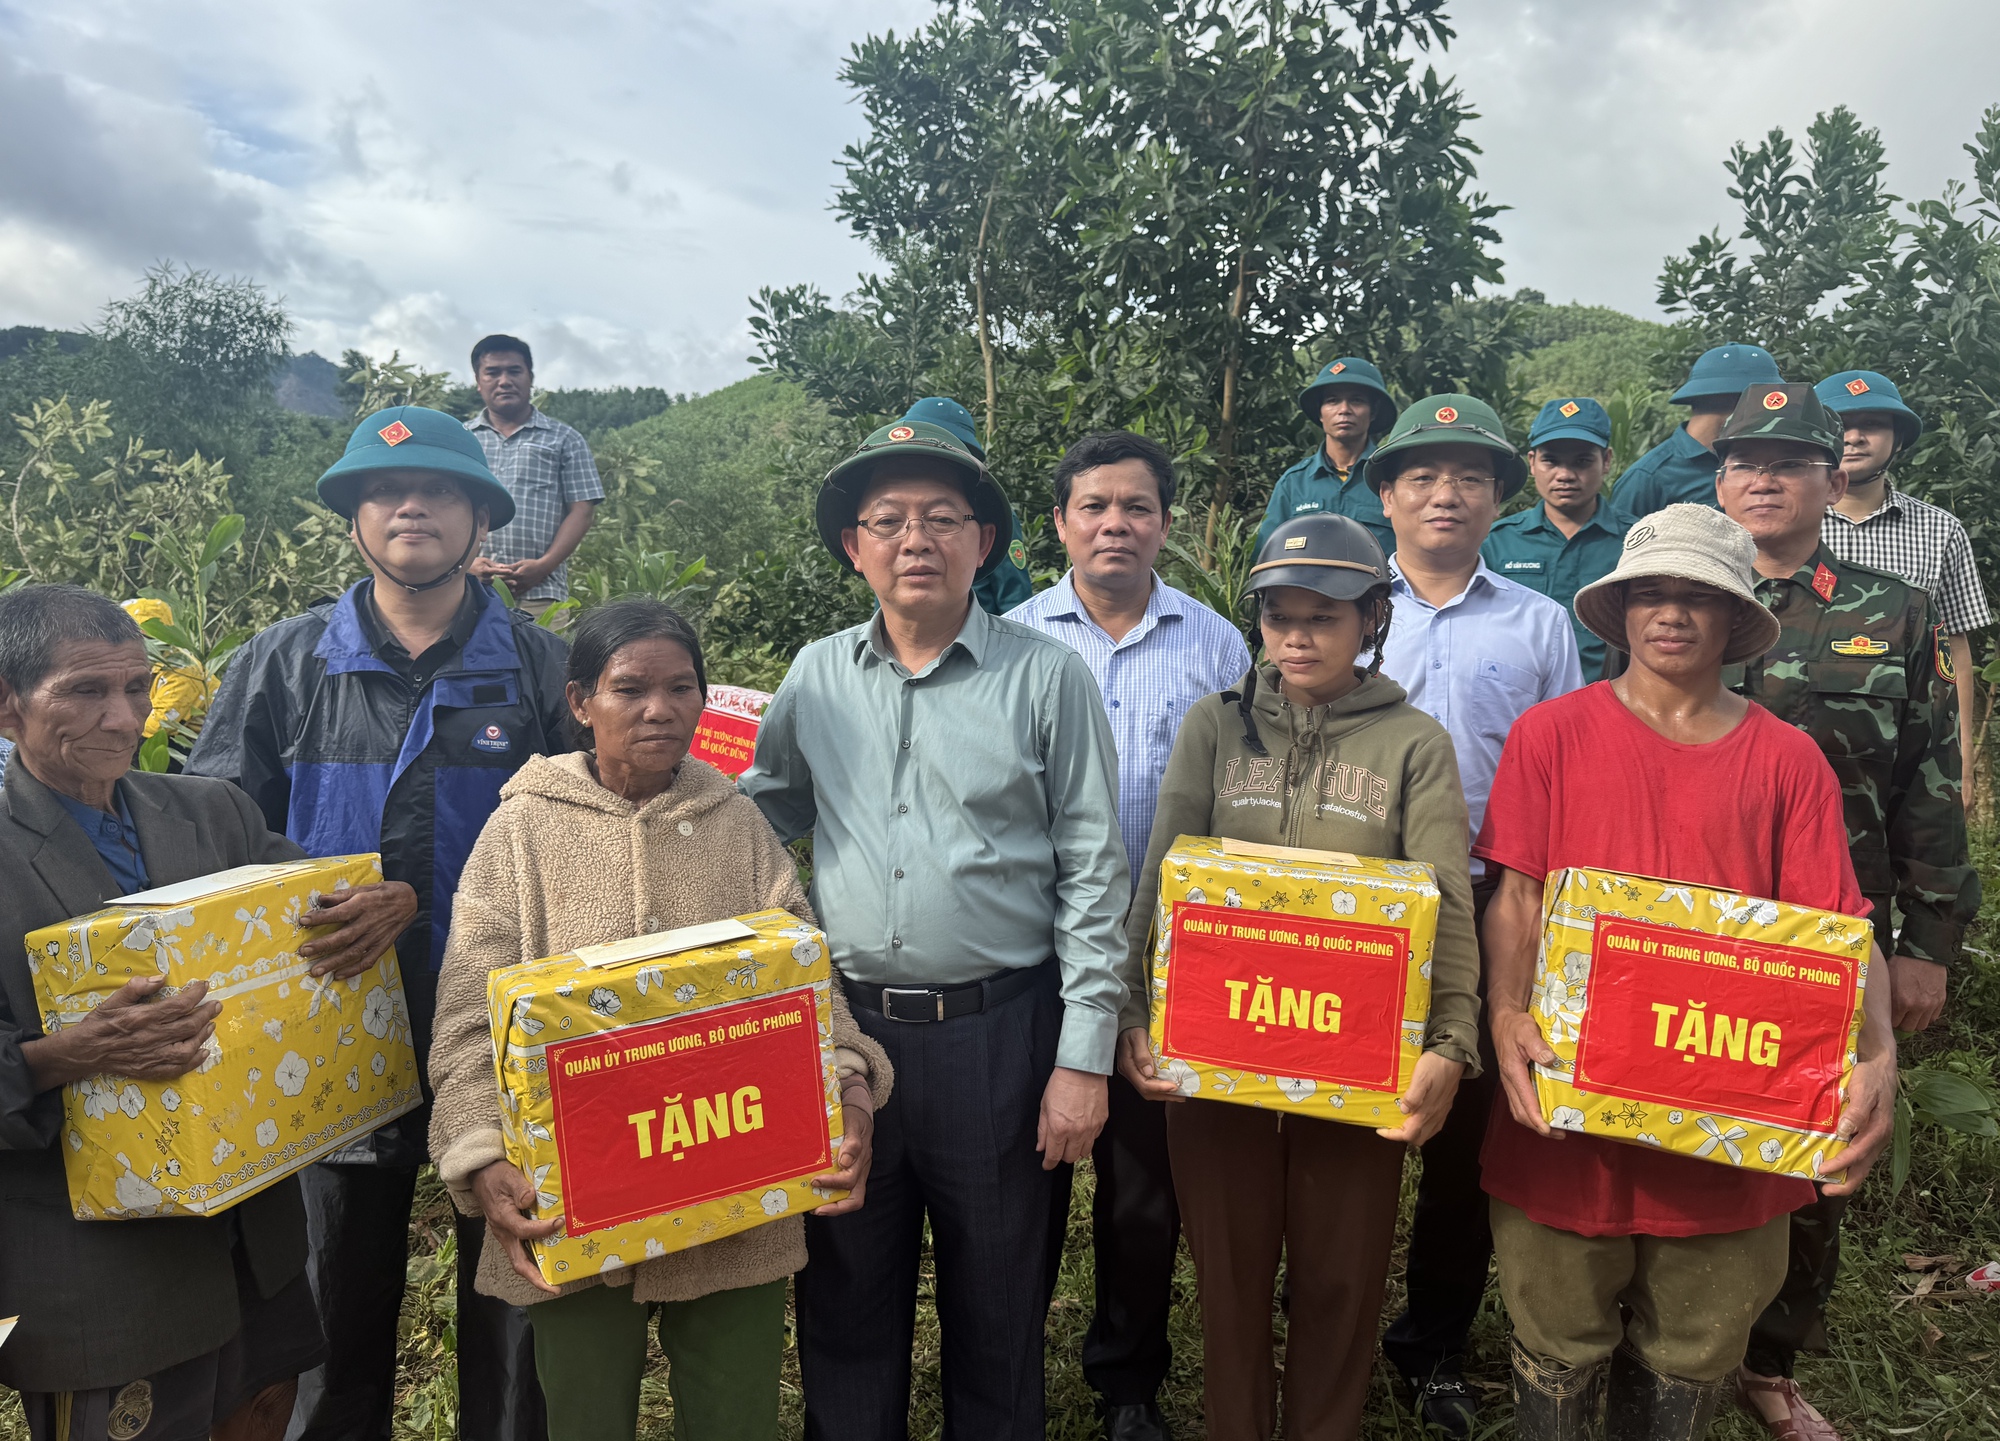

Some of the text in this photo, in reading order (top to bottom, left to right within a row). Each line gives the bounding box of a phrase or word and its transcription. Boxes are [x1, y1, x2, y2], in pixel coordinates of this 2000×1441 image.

[710, 742, 729, 756] QUỐC
[729, 748, 748, 761] DŨNG
[1183, 919, 1394, 957] QUÂN ỦY TRUNG ƯƠNG, BỘ QUỐC PHÒNG
[1606, 934, 1841, 986] QUÂN ỦY TRUNG ƯƠNG, BỘ QUỐC PHÒNG
[1224, 974, 1342, 1034] TẶNG
[1651, 999, 1782, 1068] TẶNG
[564, 1010, 802, 1077] QUÂN ỦY TRUNG ƯƠNG, BỘ QUỐC PHÒNG
[628, 1085, 764, 1162] TẶNG
